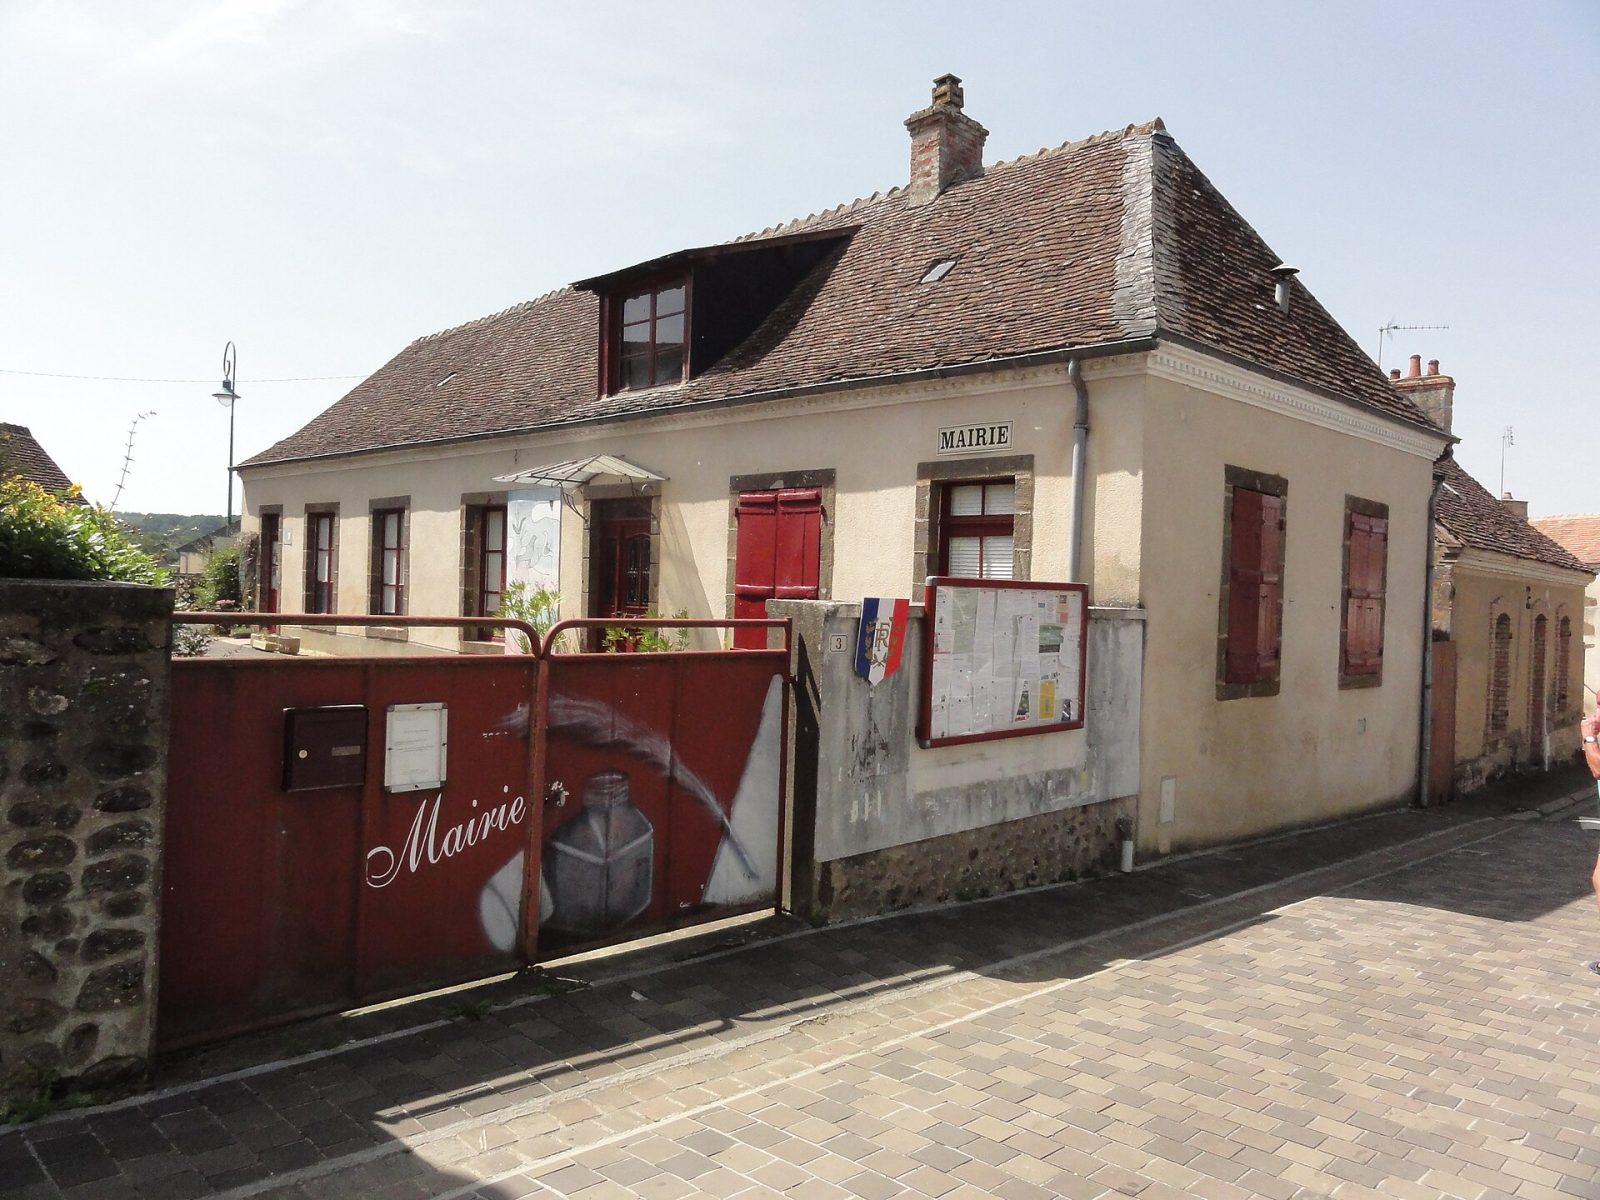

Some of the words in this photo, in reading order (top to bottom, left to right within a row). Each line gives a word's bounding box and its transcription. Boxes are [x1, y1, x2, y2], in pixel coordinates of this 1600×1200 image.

[941, 425, 1009, 449] MAIRIE
[835, 637, 842, 650] 3
[366, 785, 526, 888] Mairie
